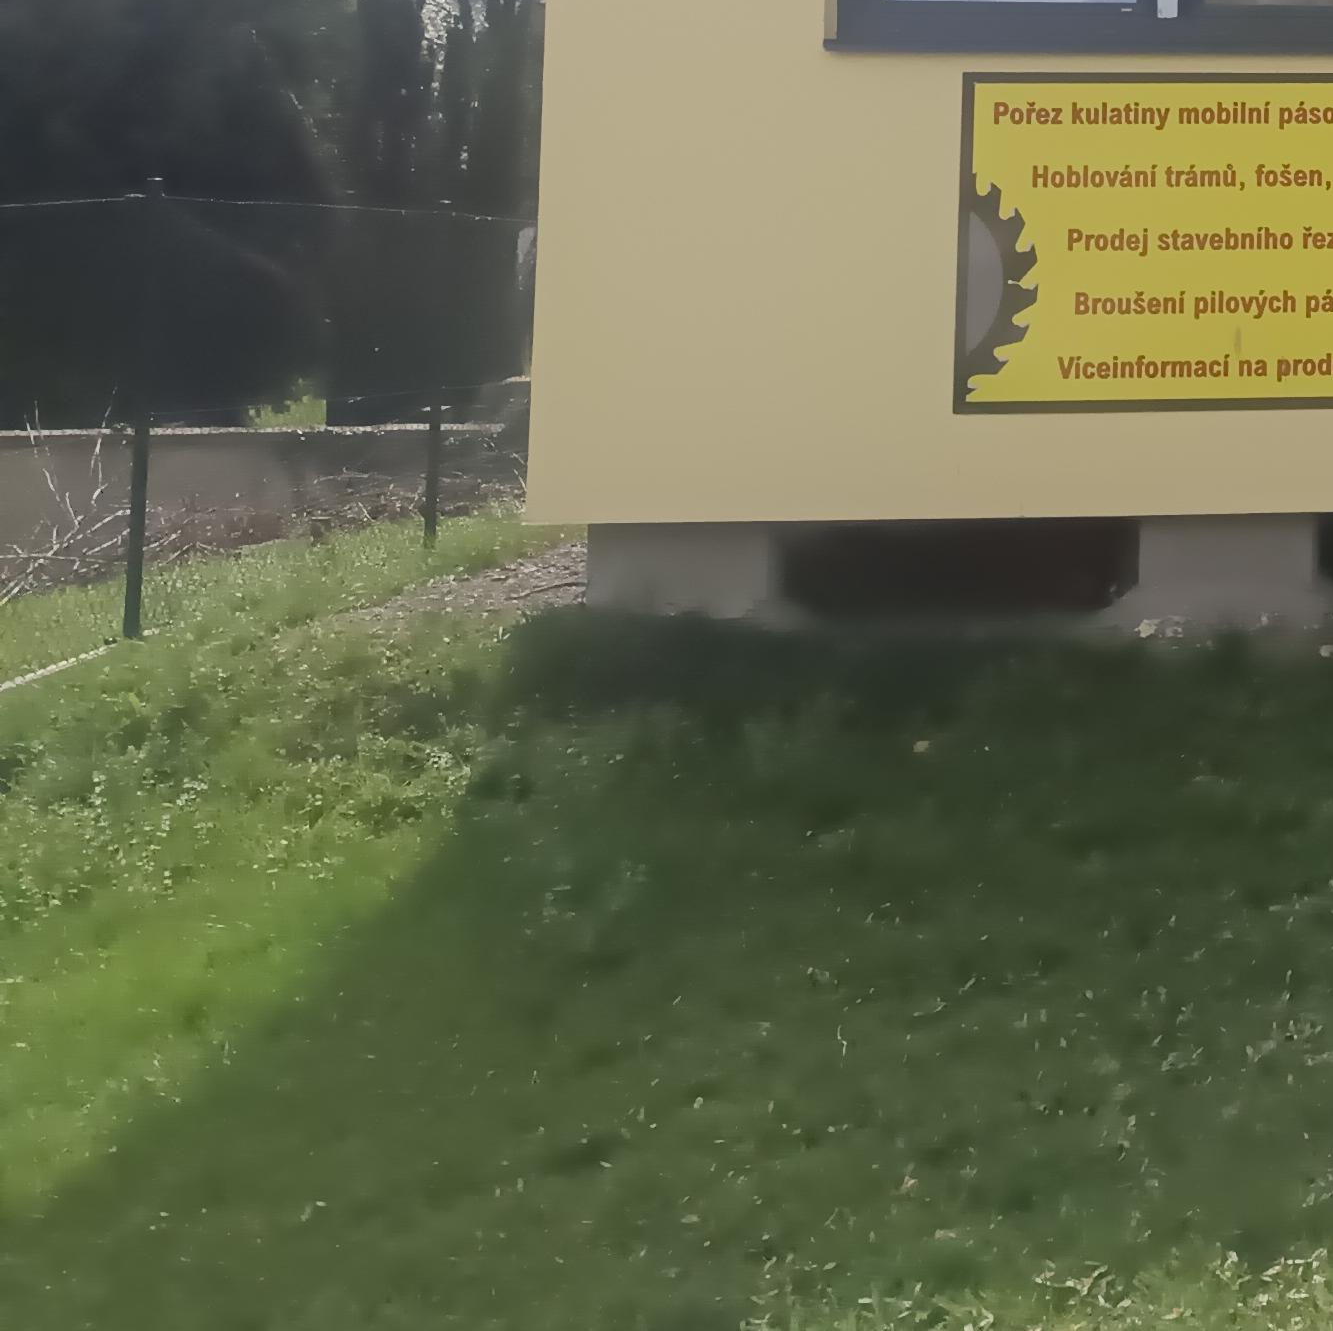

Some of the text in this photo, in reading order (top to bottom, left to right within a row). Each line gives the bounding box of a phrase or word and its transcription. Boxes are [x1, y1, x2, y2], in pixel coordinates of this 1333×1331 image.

[992, 100, 1063, 126] Pořez
[1072, 101, 1170, 130] kulatiny
[1178, 102, 1270, 125] mobilní
[1032, 165, 1157, 189] Hoblování
[1165, 164, 1245, 192] trámů,
[1255, 164, 1331, 192] fošen,
[1067, 228, 1148, 256] Prodej
[1157, 226, 1293, 251] stavebního
[1074, 291, 1185, 315] Broušení
[1194, 289, 1297, 320] pilových
[1058, 355, 1230, 380] Víceinformací
[1238, 360, 1267, 378] na
